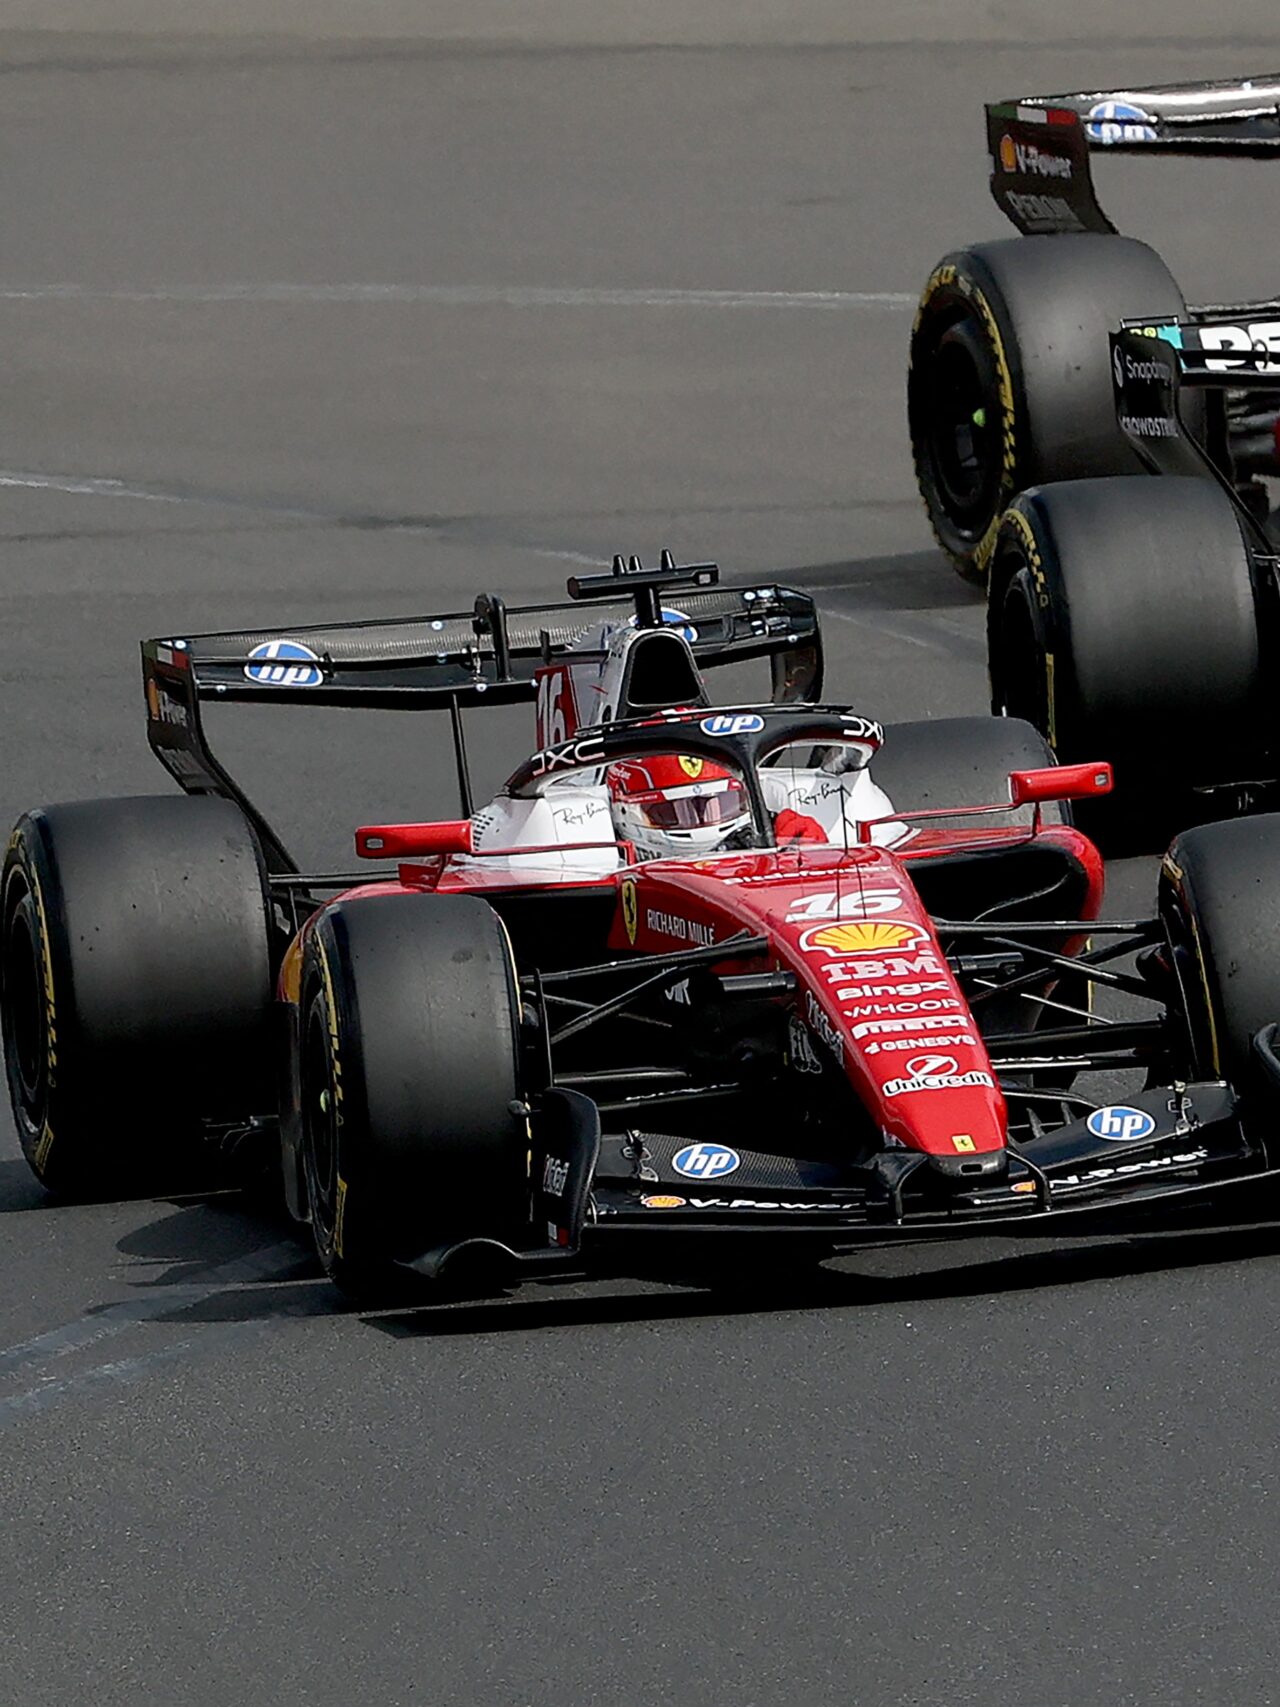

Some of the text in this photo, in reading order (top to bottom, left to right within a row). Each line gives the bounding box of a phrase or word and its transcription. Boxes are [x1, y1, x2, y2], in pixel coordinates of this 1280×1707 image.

[256, 640, 314, 686] hp
[536, 672, 567, 751] 16
[711, 714, 757, 734] hp
[785, 888, 903, 923] 16
[647, 908, 715, 947] RICHARD MILLE
[820, 956, 944, 984] IBM
[843, 998, 961, 1018] WHOOP
[851, 1014, 969, 1040] PIRELLI
[881, 1034, 977, 1051] GENESYS
[883, 1070, 994, 1097] UniCredit
[1098, 1106, 1145, 1140] hp
[680, 1143, 730, 1178] hp
[689, 1197, 862, 1209] V-Power
